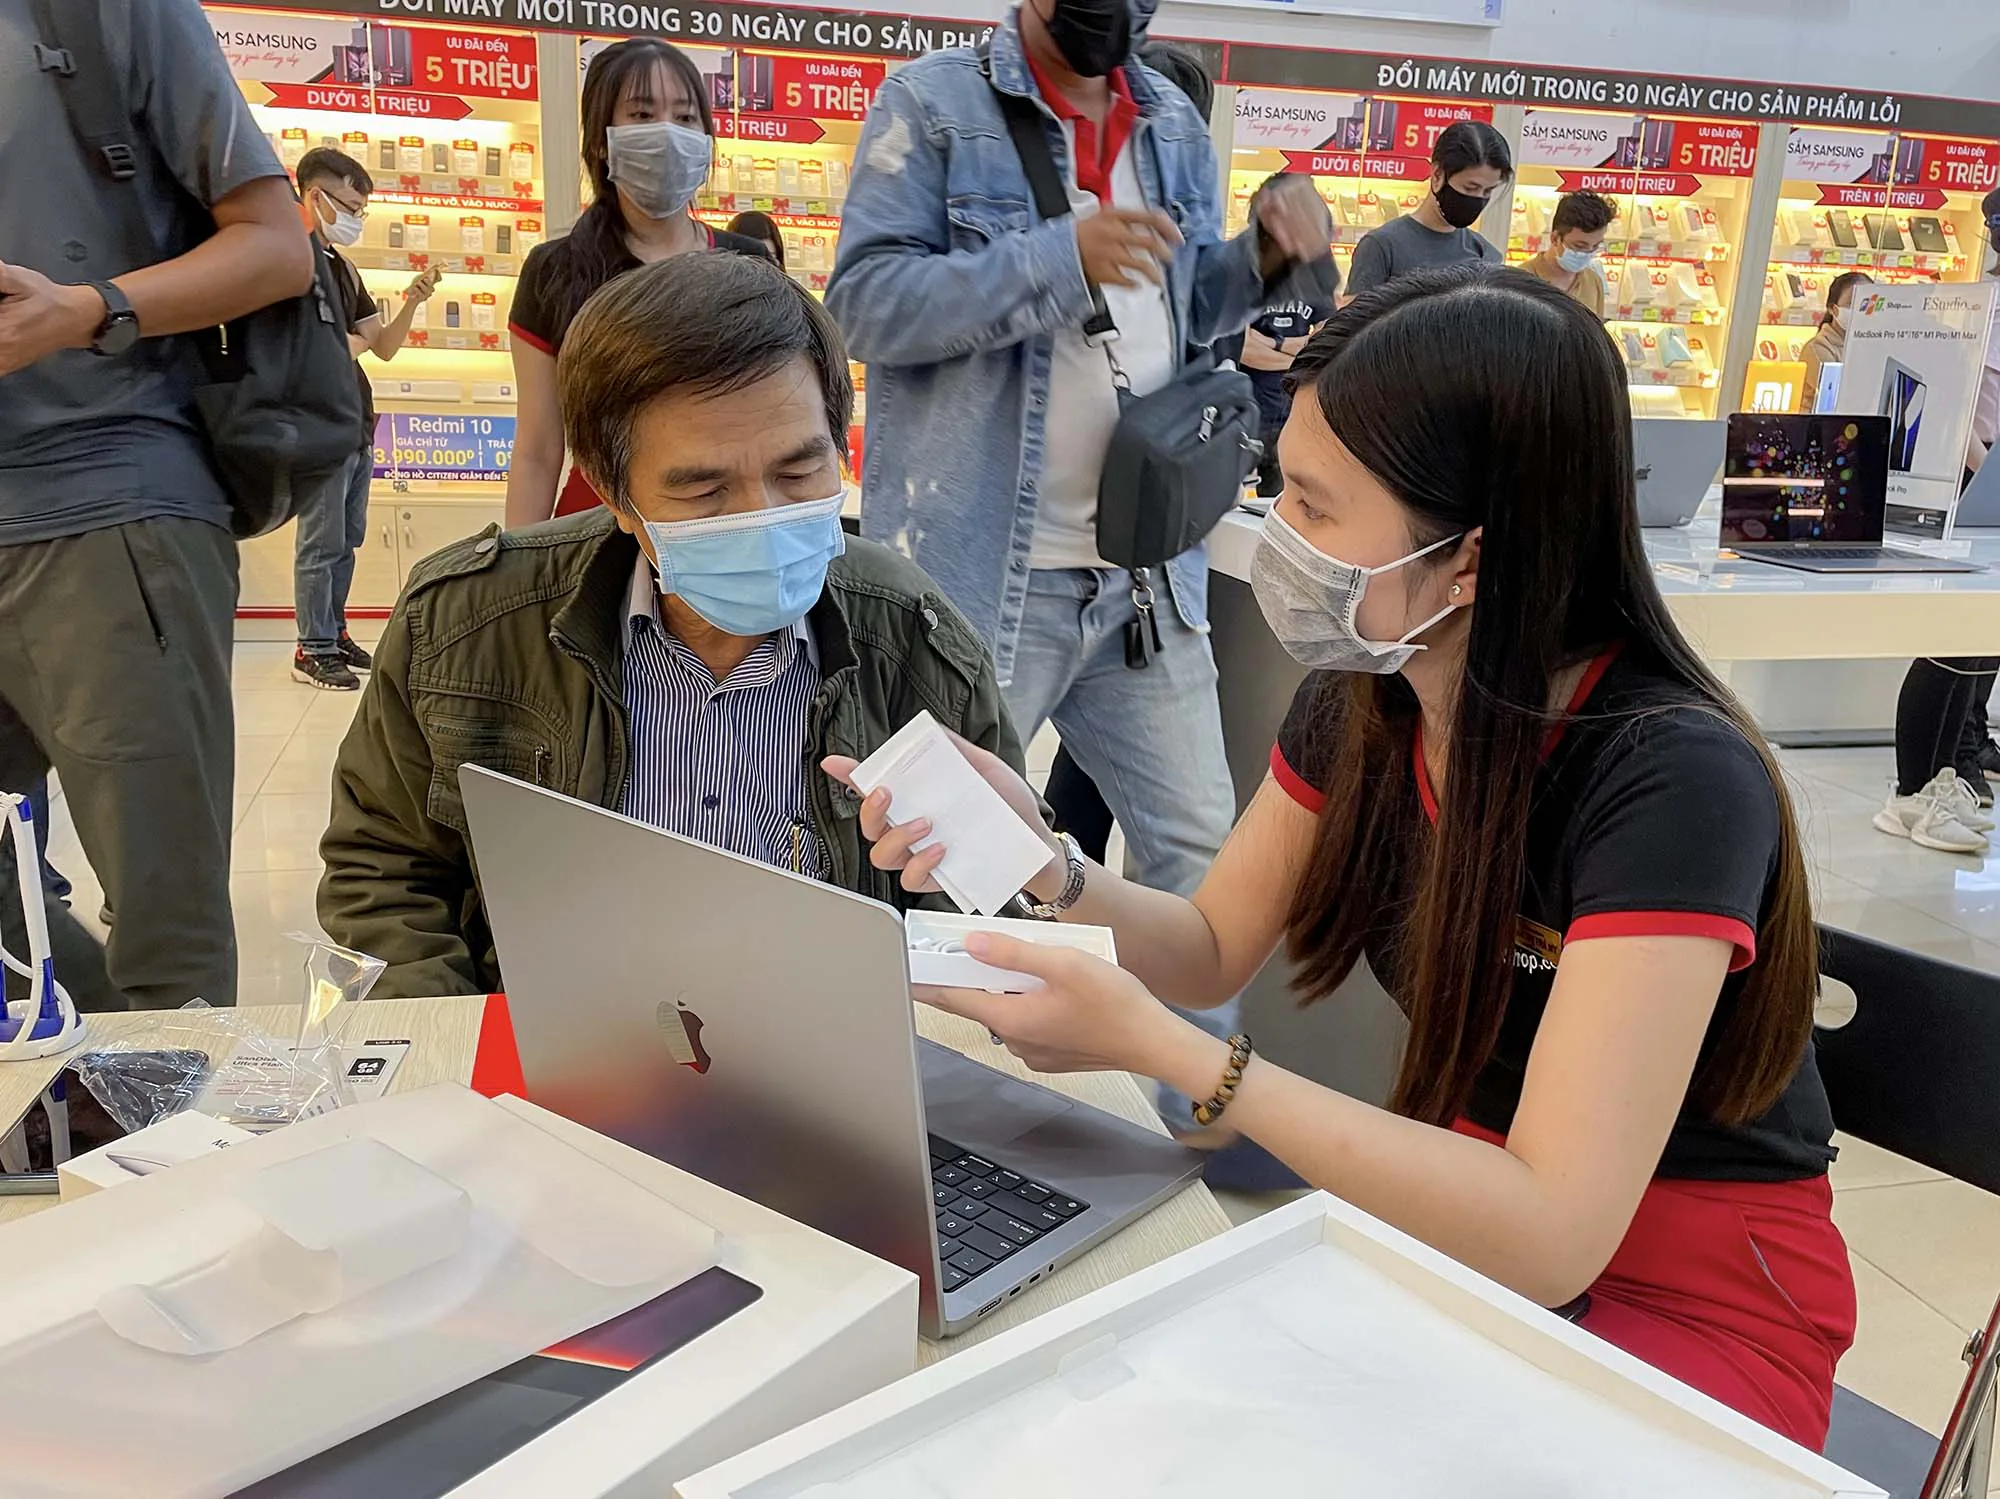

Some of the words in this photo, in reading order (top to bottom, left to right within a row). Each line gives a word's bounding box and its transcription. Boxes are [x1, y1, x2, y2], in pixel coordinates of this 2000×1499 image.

[580, 1, 681, 32] TRONG
[690, 11, 723, 36] 30
[731, 12, 807, 42] NGÀY
[814, 20, 873, 47] CHO
[880, 20, 933, 51] SẢN
[235, 32, 317, 50] SAMSUNG
[464, 38, 483, 50] ĐÃI
[486, 38, 508, 53] ĐẾN
[426, 56, 444, 82] 5
[450, 55, 531, 96] TRIỆU
[841, 64, 862, 78] ĐẾN
[786, 82, 801, 107] 5
[1377, 60, 1420, 89] ĐỔI
[1426, 66, 1476, 93] MÁY
[1481, 70, 1526, 97] MỚI
[1531, 76, 1608, 102] TRONG
[1612, 83, 1639, 104] 30
[1644, 82, 1704, 108] NGÀY
[1708, 89, 1754, 112] CHO
[1759, 88, 1800, 115] SẢN
[1805, 92, 1864, 120] PHẨM
[1869, 96, 1901, 123] LỖI
[307, 90, 356, 107] DƯỚI
[361, 94, 370, 108] 3
[376, 95, 430, 115] TRIỆU
[1264, 106, 1326, 121] SAMSUNG
[725, 119, 734, 133] 3
[740, 120, 787, 139] TRIỆU
[1405, 124, 1420, 147] 5
[1551, 127, 1608, 141] SAMSUNG
[1679, 143, 1693, 165] 5
[1699, 140, 1755, 174] TRIỆU
[1813, 144, 1864, 158] SAMSUNG
[1312, 156, 1349, 171] DƯỚI
[1353, 160, 1360, 172] 6
[1365, 160, 1405, 177] TRIỆU
[1929, 160, 1941, 181] 5
[1946, 158, 1996, 190] TRIỆU
[1620, 179, 1634, 190] 10
[1638, 178, 1676, 193] TRIỆU
[1840, 188, 1871, 203] TRÊN
[1874, 192, 1886, 203] 10
[1891, 192, 1925, 207] TRIỆU
[1884, 331, 1895, 339] Pro
[409, 417, 464, 434] Redmi
[471, 419, 492, 435] 10
[396, 437, 414, 447] GIÁ
[426, 471, 458, 480] CITIZEN
